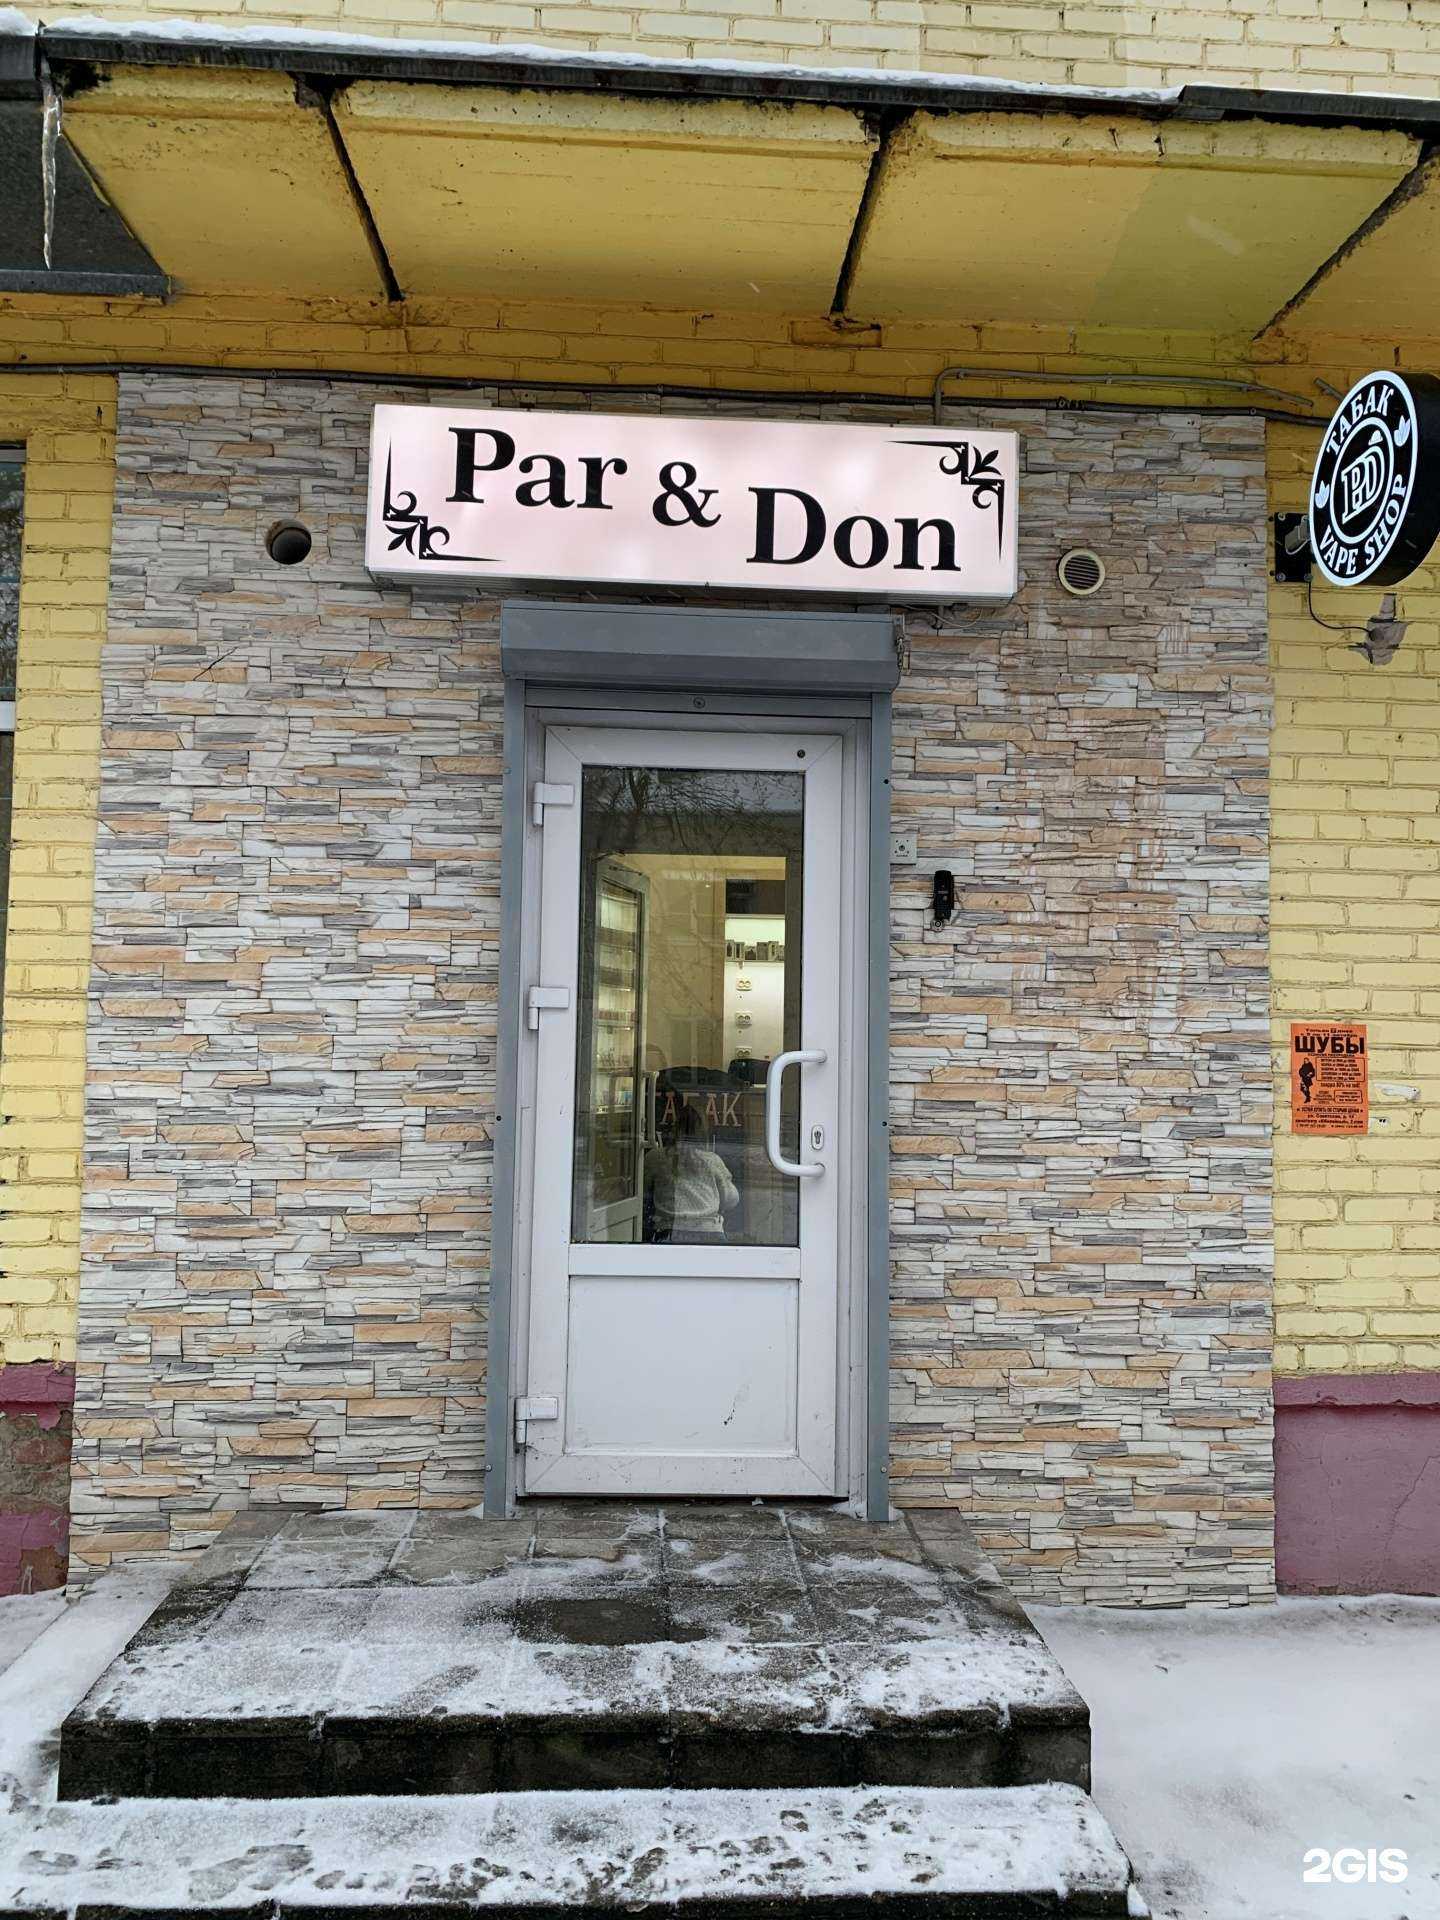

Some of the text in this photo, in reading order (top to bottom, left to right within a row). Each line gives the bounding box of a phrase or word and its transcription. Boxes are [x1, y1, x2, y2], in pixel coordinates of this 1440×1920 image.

[1326, 384, 1395, 456] ТАБАК
[445, 426, 962, 572] Par & Don
[1319, 473, 1408, 576] VAPE SHOP
[1294, 1035, 1365, 1054] ШУБЫ
[655, 1091, 742, 1127] ААК
